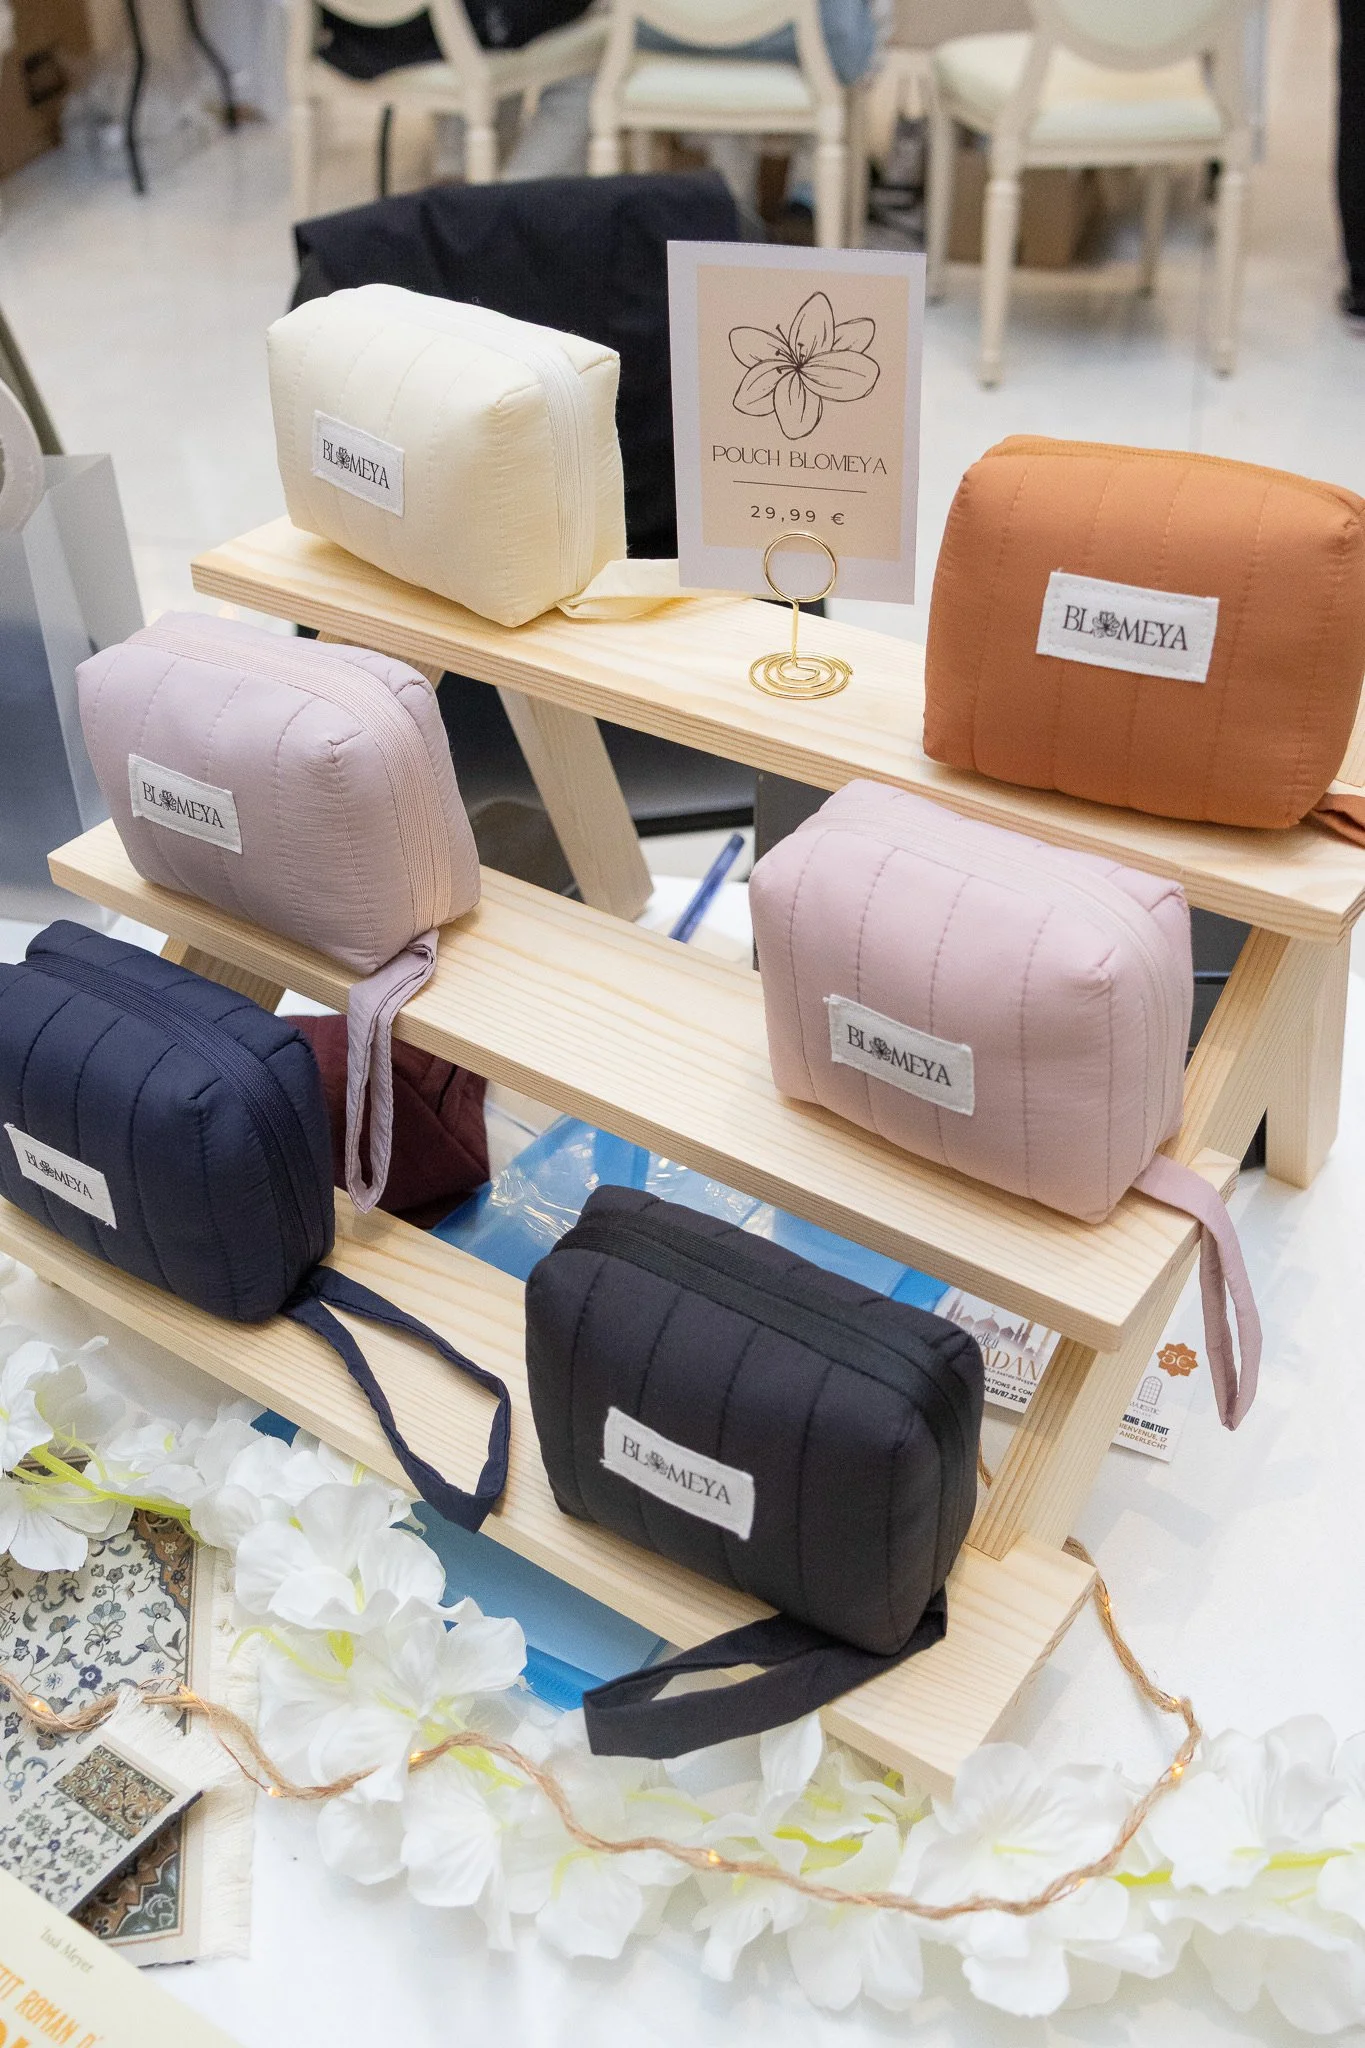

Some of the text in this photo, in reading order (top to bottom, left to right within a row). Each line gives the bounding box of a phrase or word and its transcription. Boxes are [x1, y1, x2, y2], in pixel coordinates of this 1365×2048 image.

[712, 445, 888, 475] POUCH BLOMEYA
[750, 505, 845, 526] 29,99 €
[1141, 1420, 1170, 1436] GRATUIT
